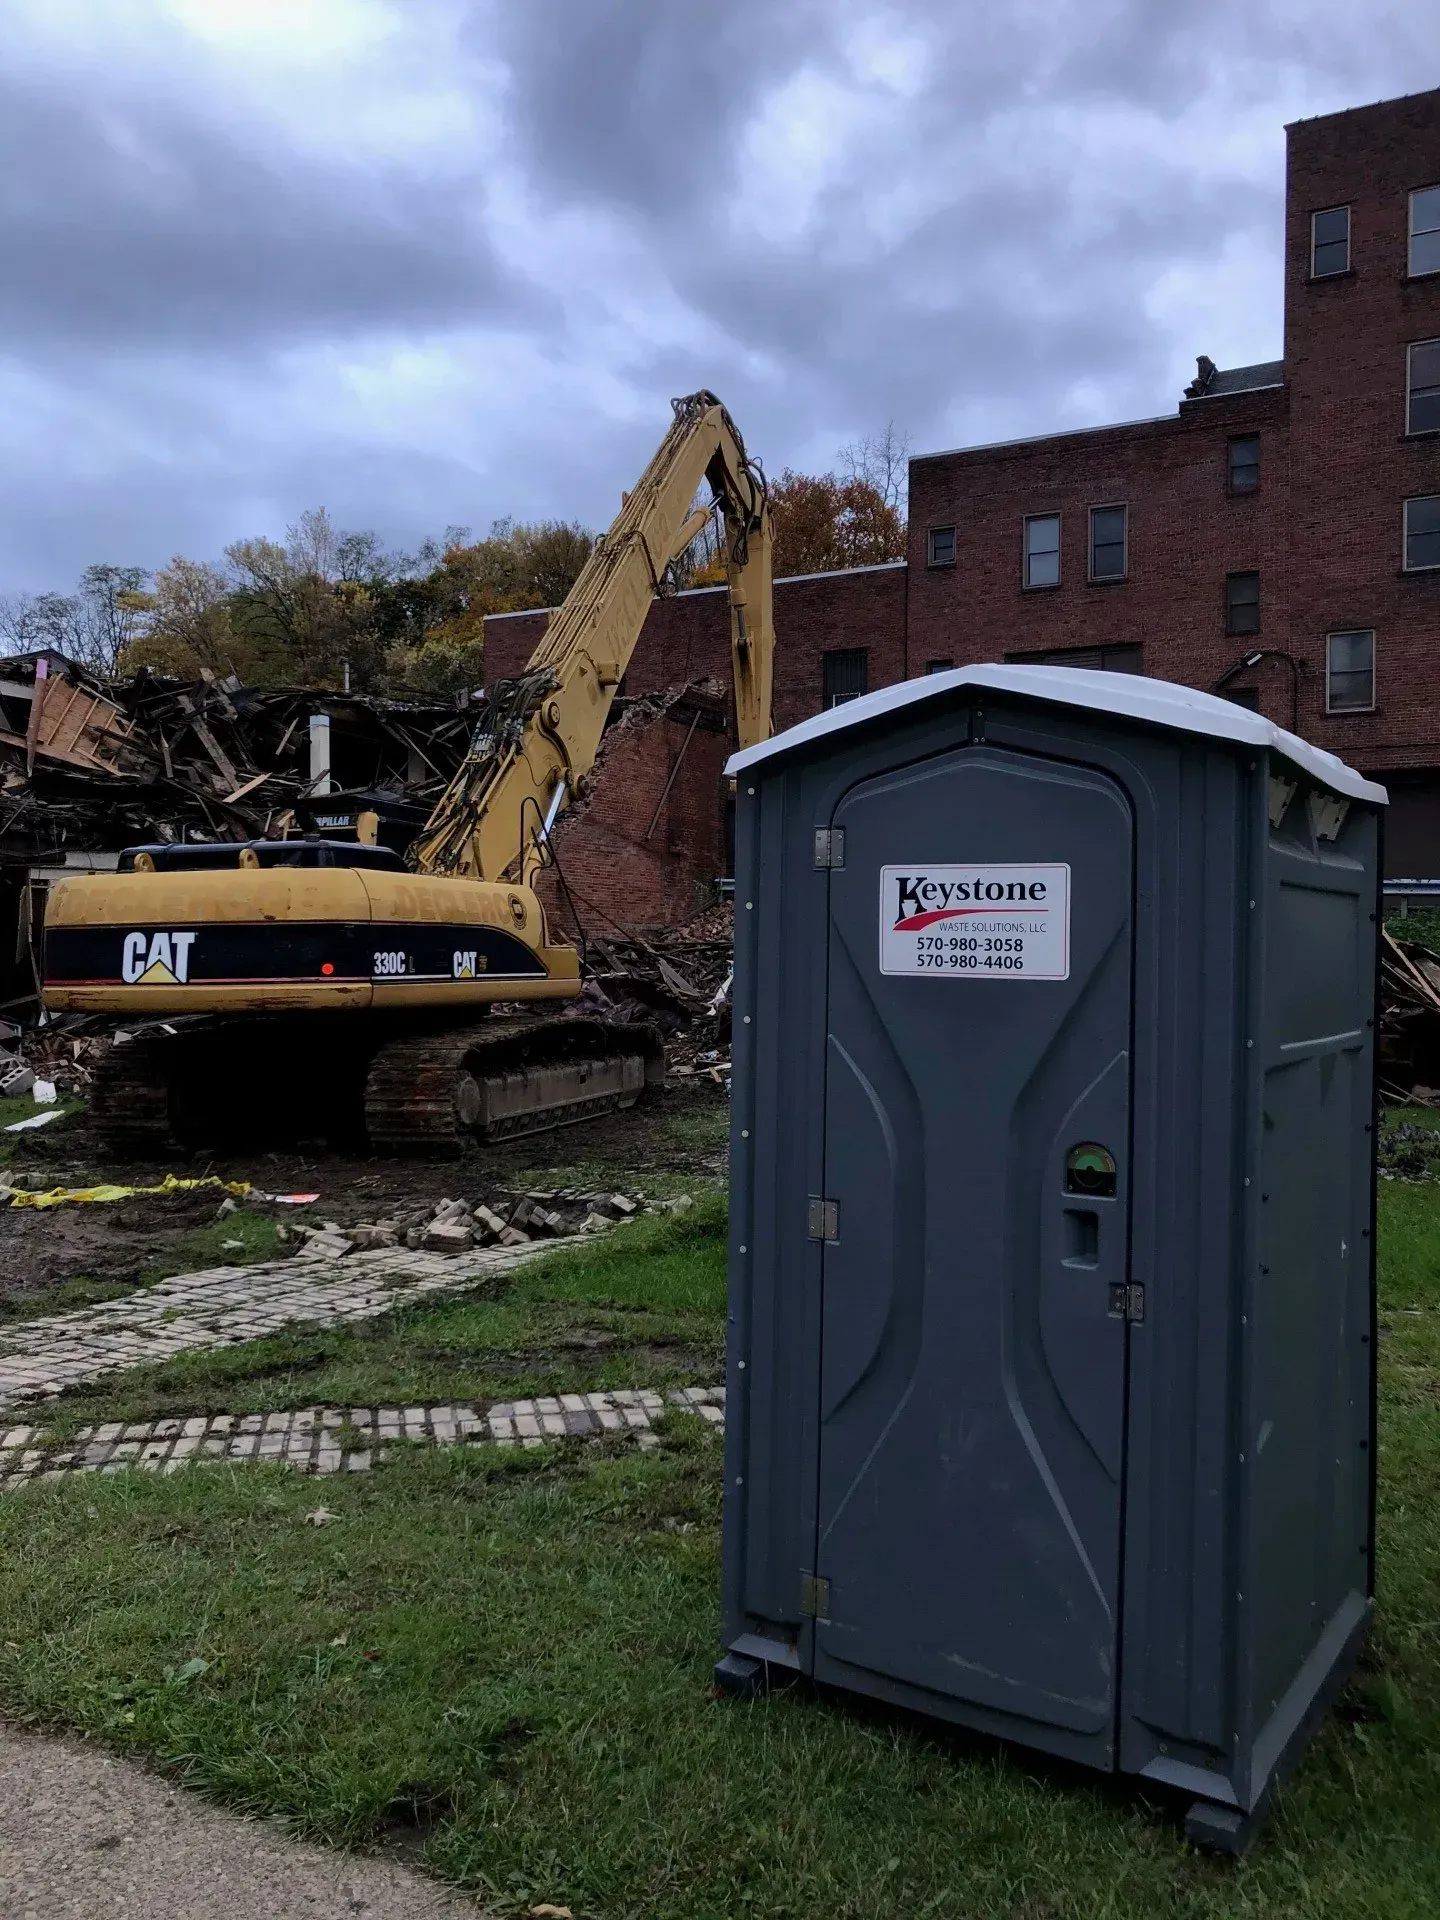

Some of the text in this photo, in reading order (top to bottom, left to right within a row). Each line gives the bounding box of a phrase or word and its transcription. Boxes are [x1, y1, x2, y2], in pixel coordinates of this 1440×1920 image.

[894, 876, 1047, 924] Keystone
[939, 922, 1047, 933] WASTE SOLUTIONS, LLC
[916, 937, 1024, 952] 570-980-3058
[122, 931, 196, 984] CAT
[373, 951, 406, 974] 330C
[453, 950, 477, 978] CAT
[916, 954, 1024, 970] 570-980-4406
